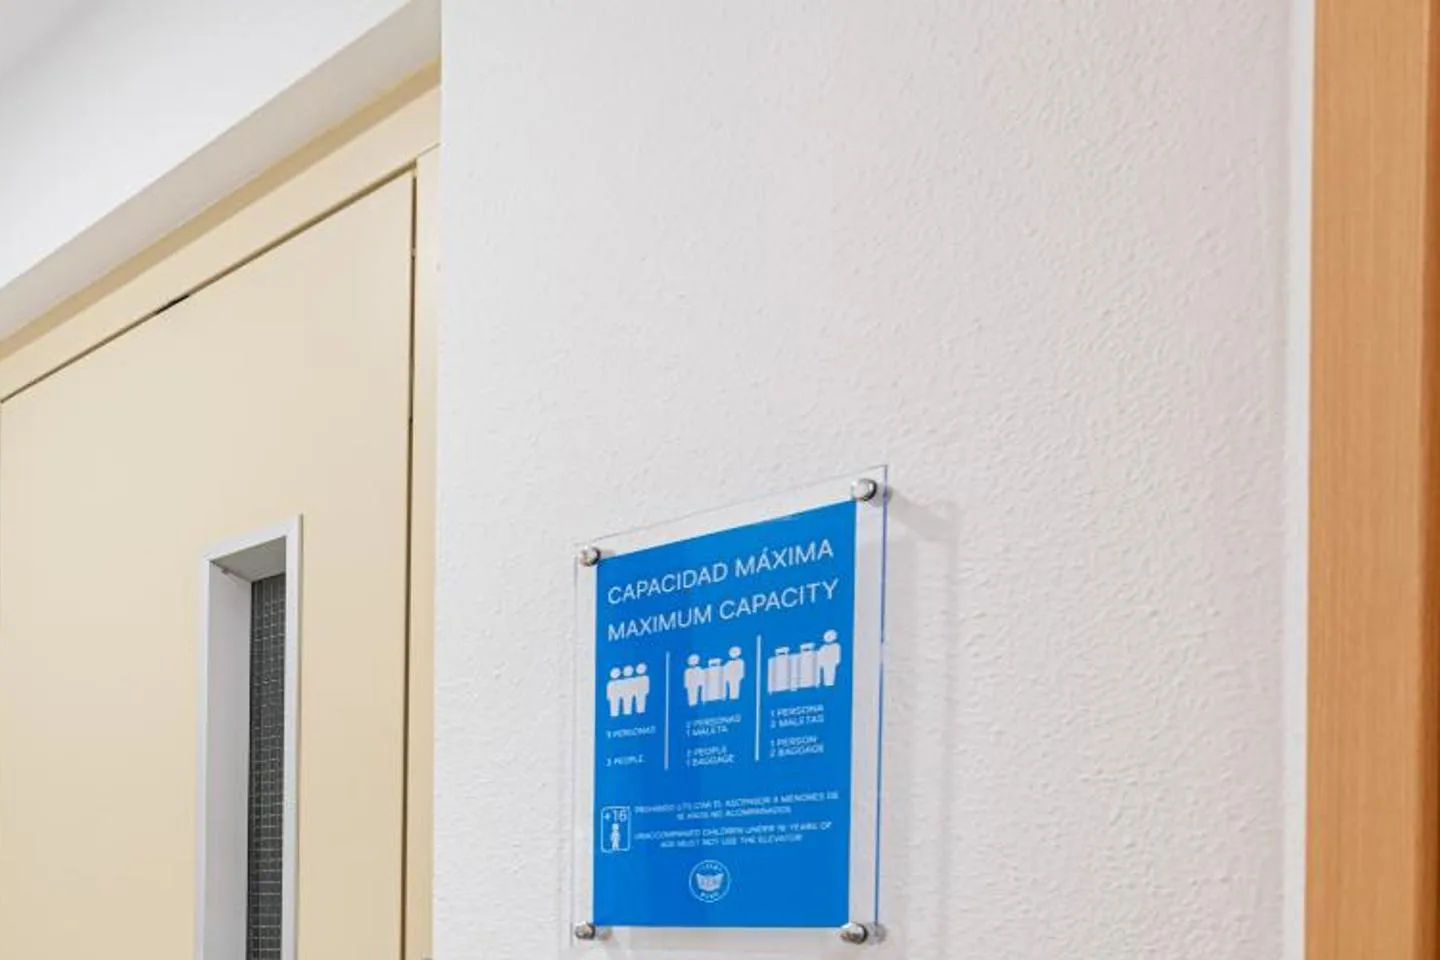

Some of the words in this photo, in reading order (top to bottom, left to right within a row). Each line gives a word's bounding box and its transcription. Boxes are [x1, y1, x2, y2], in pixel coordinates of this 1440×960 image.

[608, 563, 728, 605] CAPACIDAD
[735, 538, 834, 578] MÁXIMA
[608, 605, 712, 642] MAXIMUM
[719, 578, 839, 621] CAPACITY
